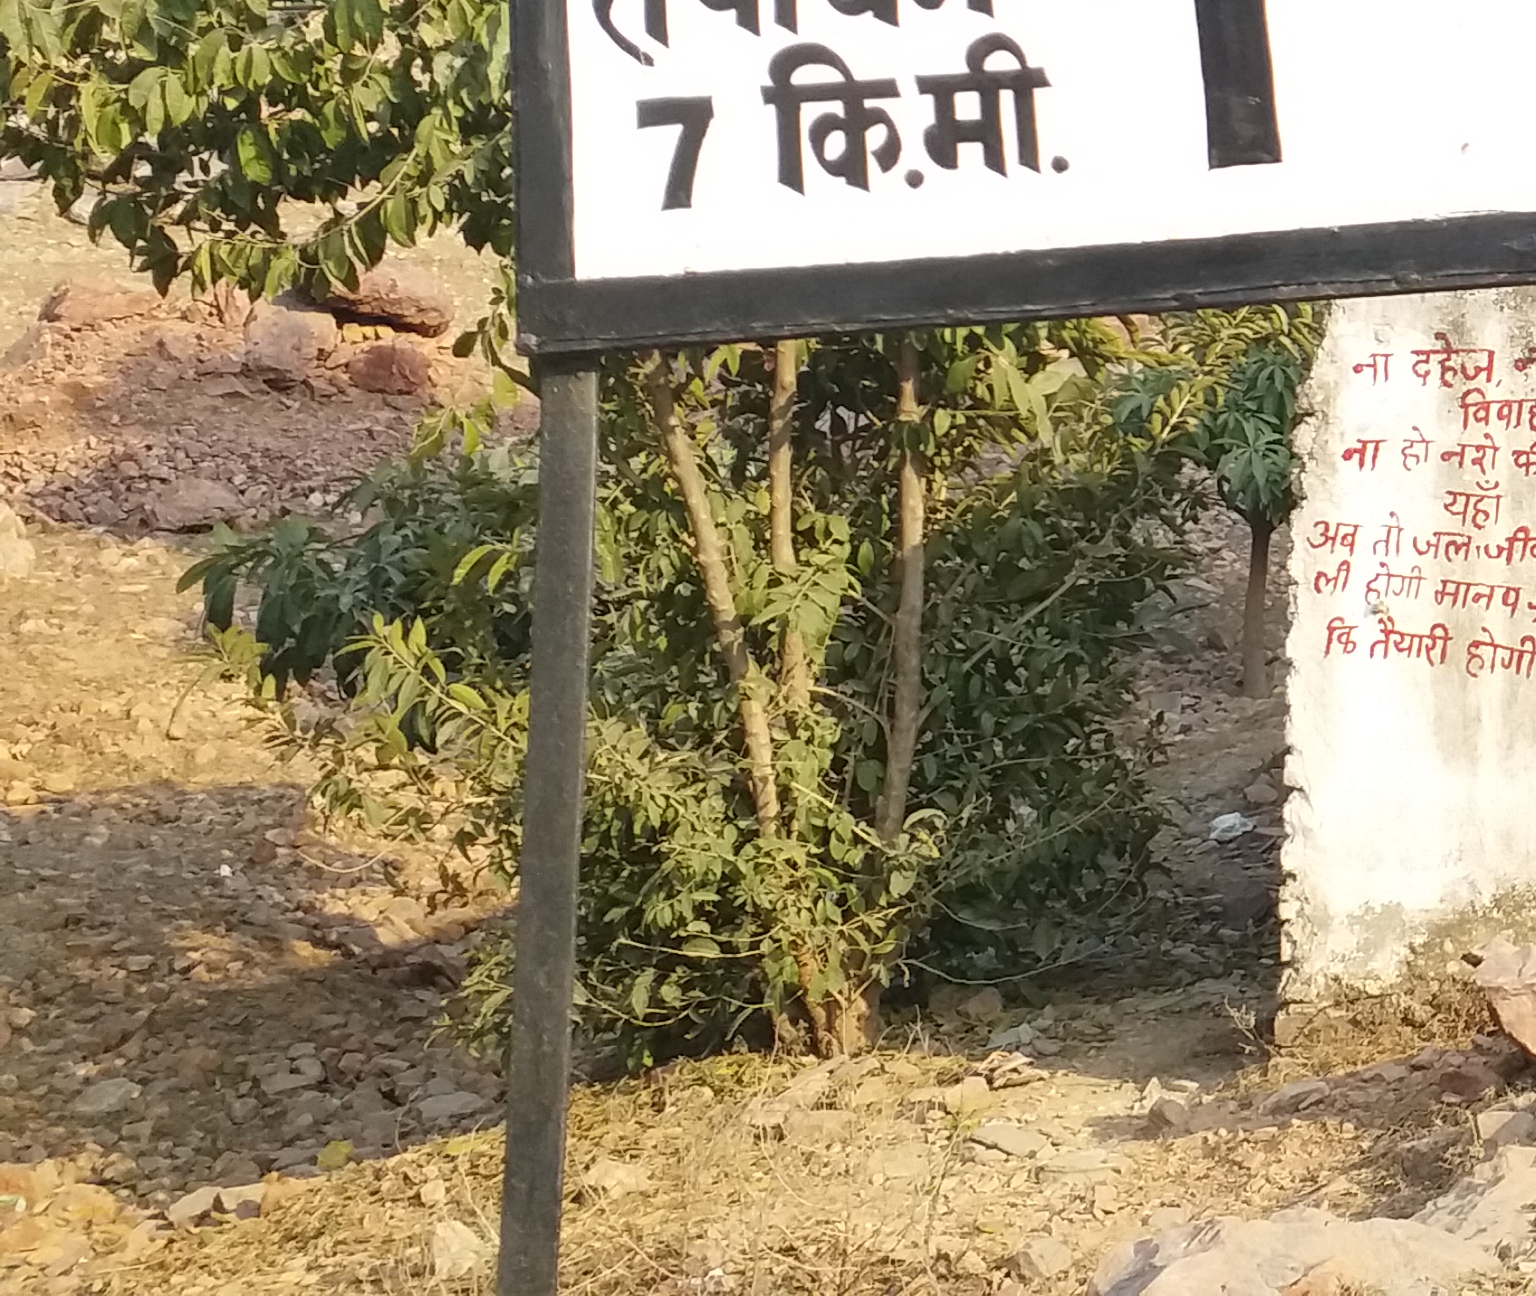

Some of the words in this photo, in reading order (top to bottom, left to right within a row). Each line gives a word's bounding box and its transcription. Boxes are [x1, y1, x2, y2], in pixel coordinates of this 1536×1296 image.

[636, 97, 714, 211] 7
[762, 32, 1069, 195] कि.मी.
[1352, 353, 1394, 386] ना
[1341, 439, 1388, 472] ना
[1401, 426, 1436, 471] हो
[1444, 480, 1503, 530] यहाँ
[1306, 520, 1363, 557] अब
[1373, 511, 1404, 557] तो
[1314, 559, 1350, 596] ली
[1365, 561, 1427, 605] होगी
[1324, 616, 1359, 659] कि
[1369, 615, 1453, 667] तैयारी
